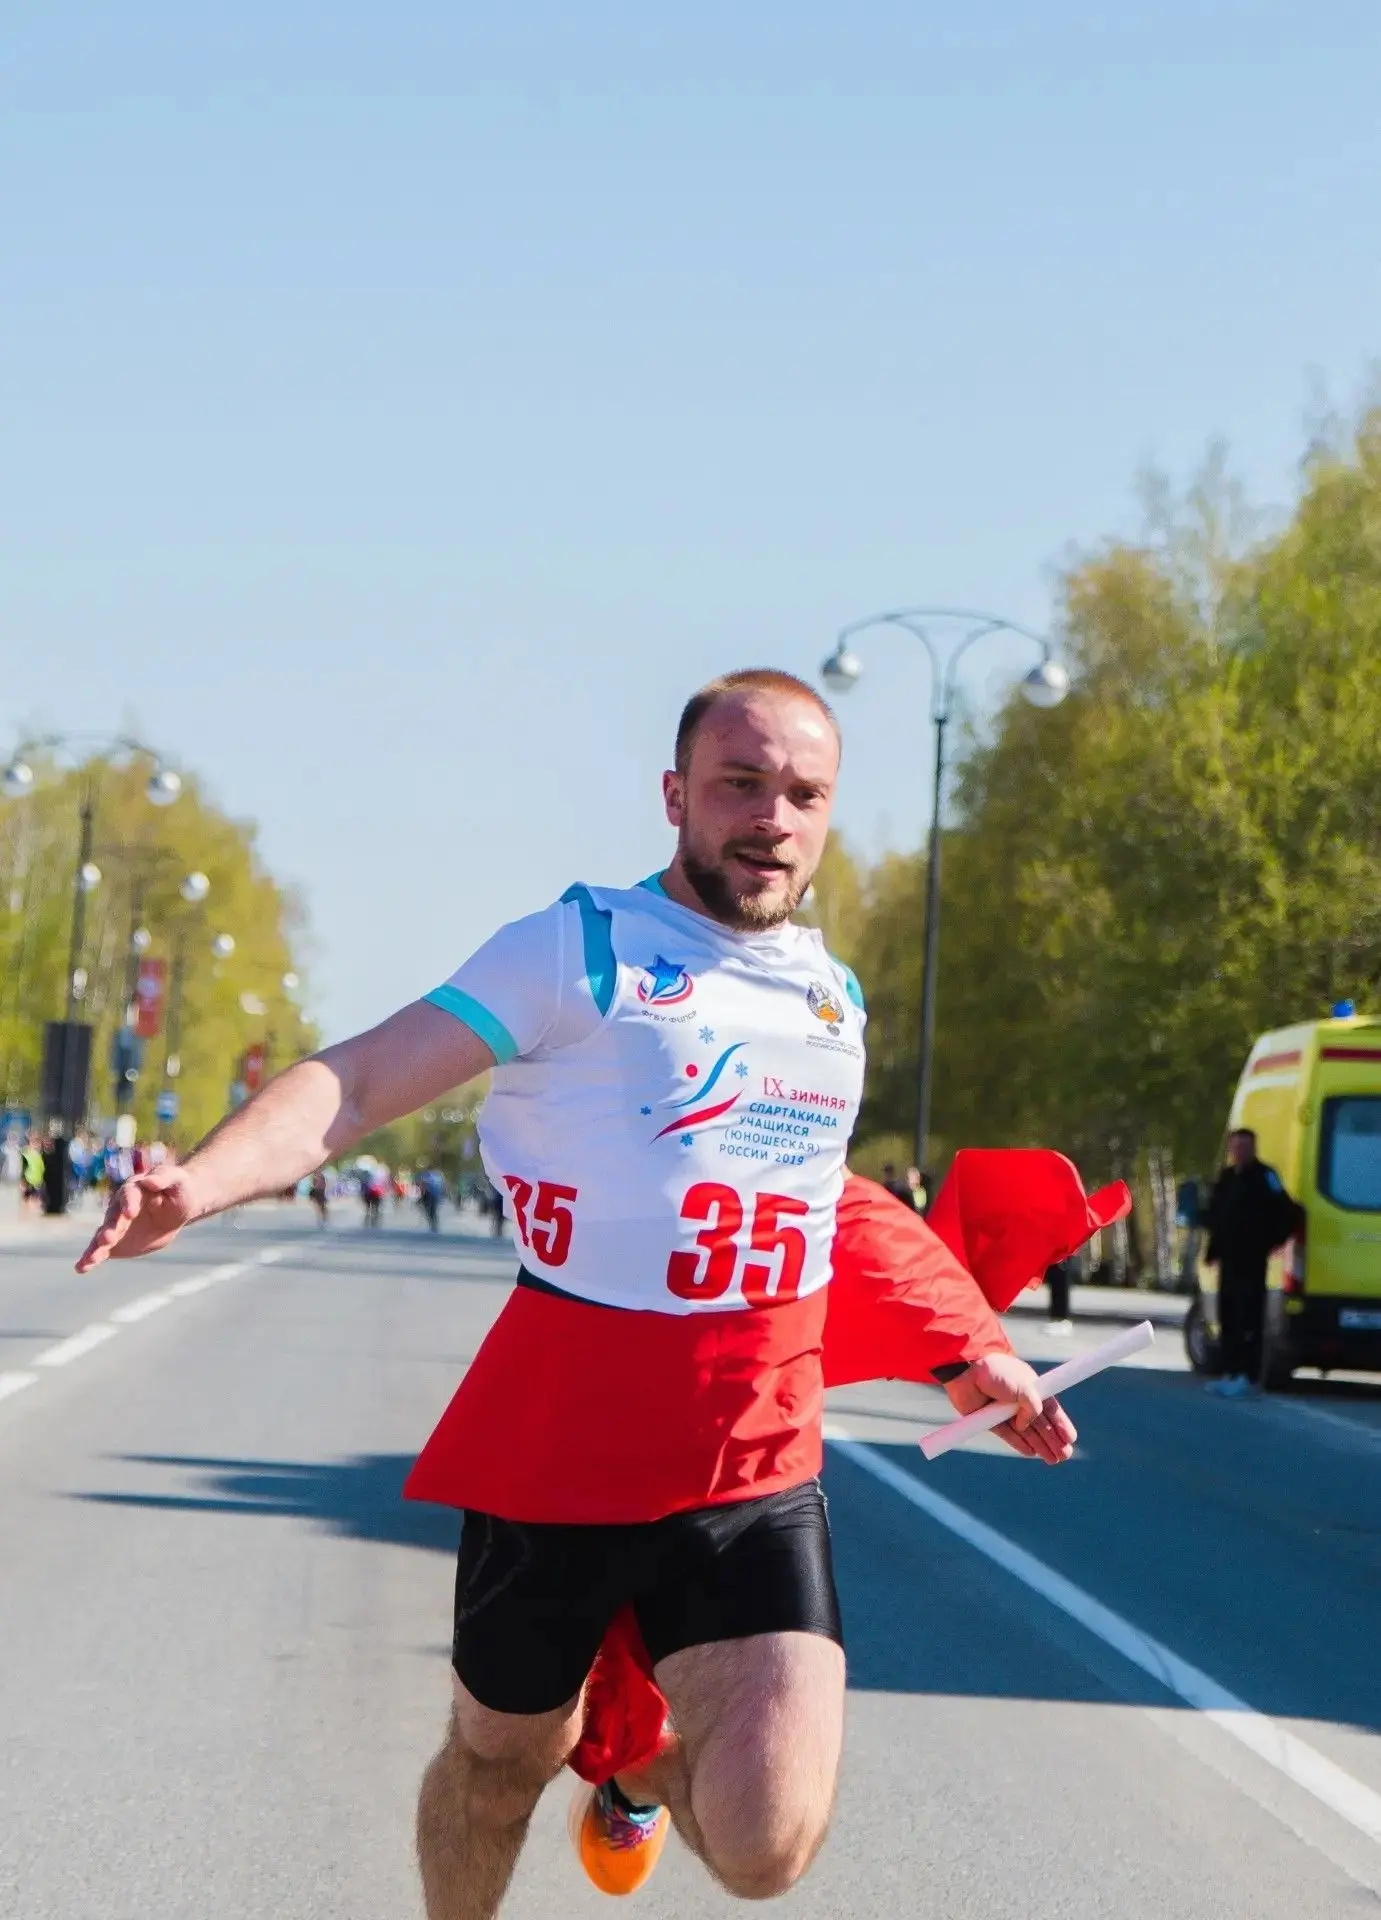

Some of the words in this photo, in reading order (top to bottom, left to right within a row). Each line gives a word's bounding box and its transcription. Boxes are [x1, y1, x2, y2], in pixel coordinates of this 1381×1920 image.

[789, 1088, 846, 1112] ЗИМНЯЯ
[739, 1115, 810, 1137] УЧАЩИХСЯ
[749, 1102, 838, 1128] СПАРТАКИАДА
[724, 1127, 821, 1156] (ЮНОШЕСКАЯ)
[719, 1143, 769, 1161] РОССИИ
[775, 1152, 805, 1166] 2019
[667, 1182, 810, 1309] 35
